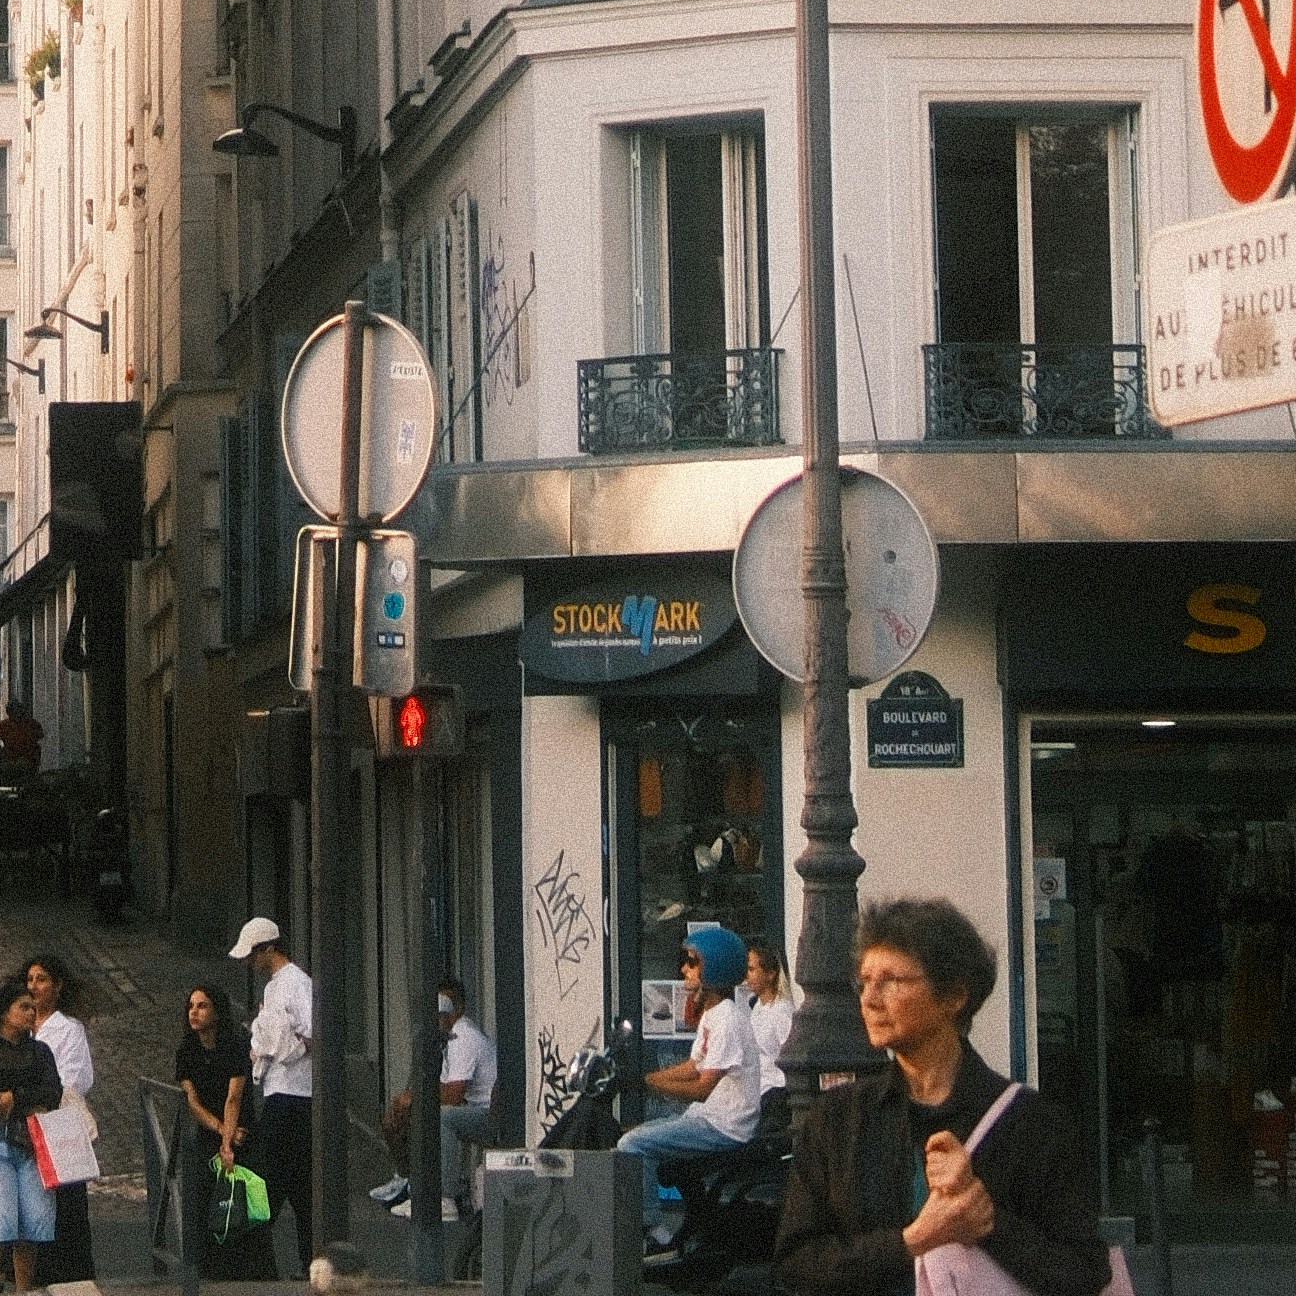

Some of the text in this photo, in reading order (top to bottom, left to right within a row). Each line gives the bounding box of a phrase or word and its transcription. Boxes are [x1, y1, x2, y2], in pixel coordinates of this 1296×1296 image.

[1188, 232, 1288, 274] INTERDIT
[1160, 363, 1186, 391] DE
[1257, 340, 1281, 370] DE
[552, 595, 701, 656] STOCKMARK
[883, 711, 947, 724] BOULEVARD
[874, 743, 957, 756] ROCHECHOUART
